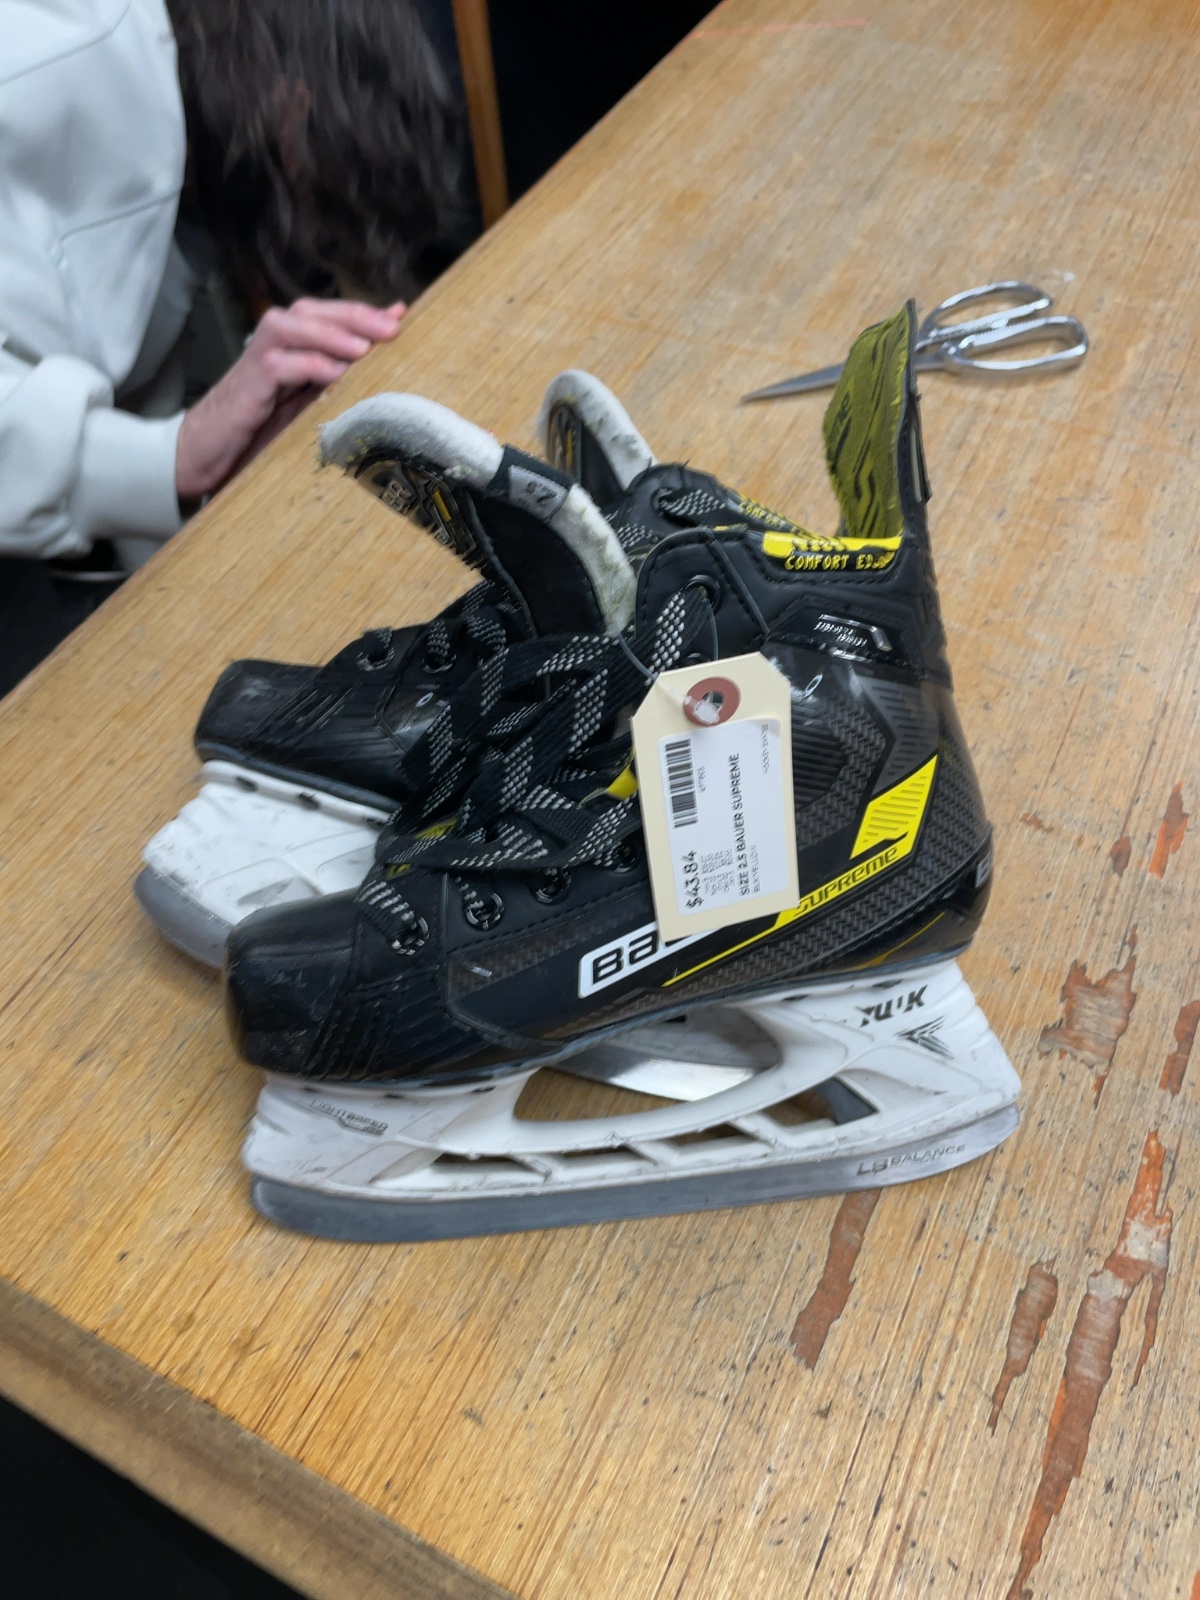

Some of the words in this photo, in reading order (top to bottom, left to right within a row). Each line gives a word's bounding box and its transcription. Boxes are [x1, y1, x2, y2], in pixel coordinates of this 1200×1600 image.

[739, 500, 785, 530] COMFORT
[785, 554, 849, 571] COMFORT
[728, 752, 744, 811] SUPREME
[732, 811, 747, 852] BAUER
[736, 852, 749, 870] 2.5
[682, 850, 705, 909] $43.84
[737, 870, 750, 896] SIZE
